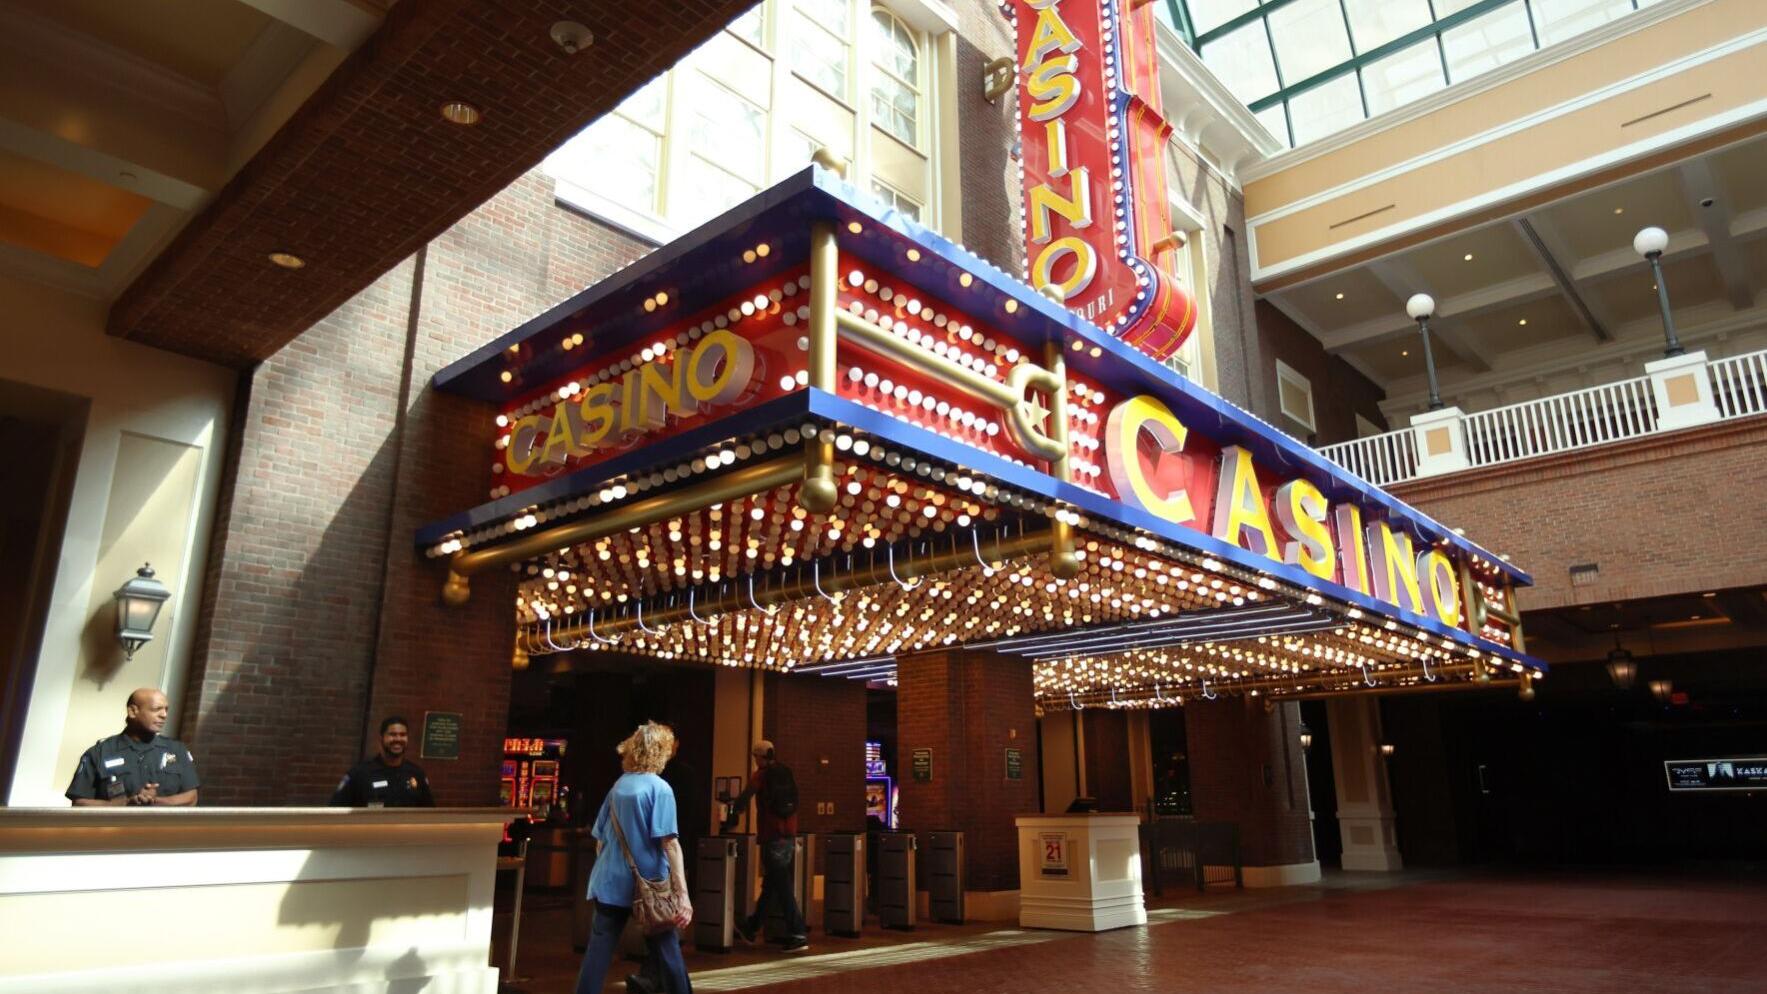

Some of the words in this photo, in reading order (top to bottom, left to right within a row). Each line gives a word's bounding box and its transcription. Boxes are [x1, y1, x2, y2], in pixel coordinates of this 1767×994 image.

[1021, 0, 1097, 300] ASINO
[506, 330, 755, 475] CASINO
[1105, 394, 1461, 628] CASINO
[1046, 844, 1062, 860] 21
